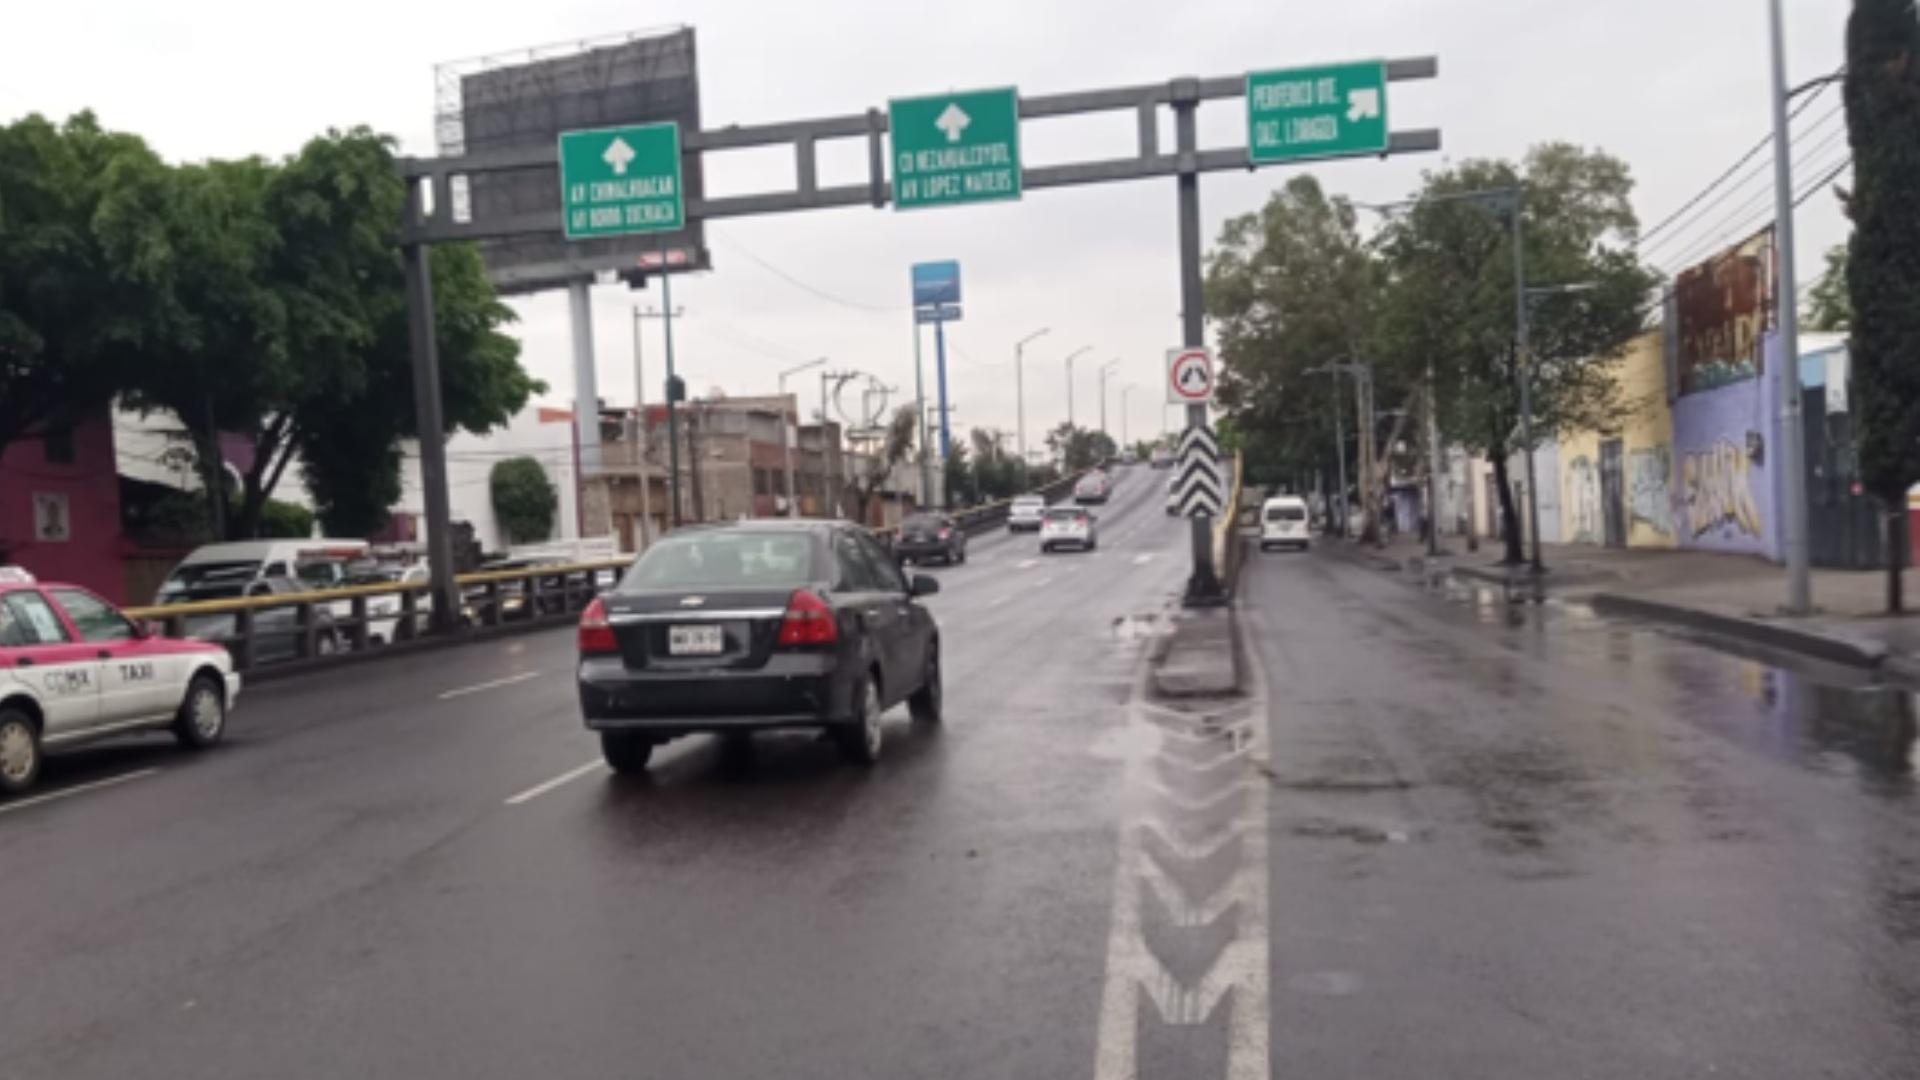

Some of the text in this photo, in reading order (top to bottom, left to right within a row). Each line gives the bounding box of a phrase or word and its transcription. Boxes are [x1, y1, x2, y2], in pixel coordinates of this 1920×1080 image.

[1253, 80, 1313, 111] PERIFERICO
[923, 174, 961, 198] LOPEZ
[965, 168, 1011, 192] MATEOS
[43, 663, 154, 693] CDMX TAXI
